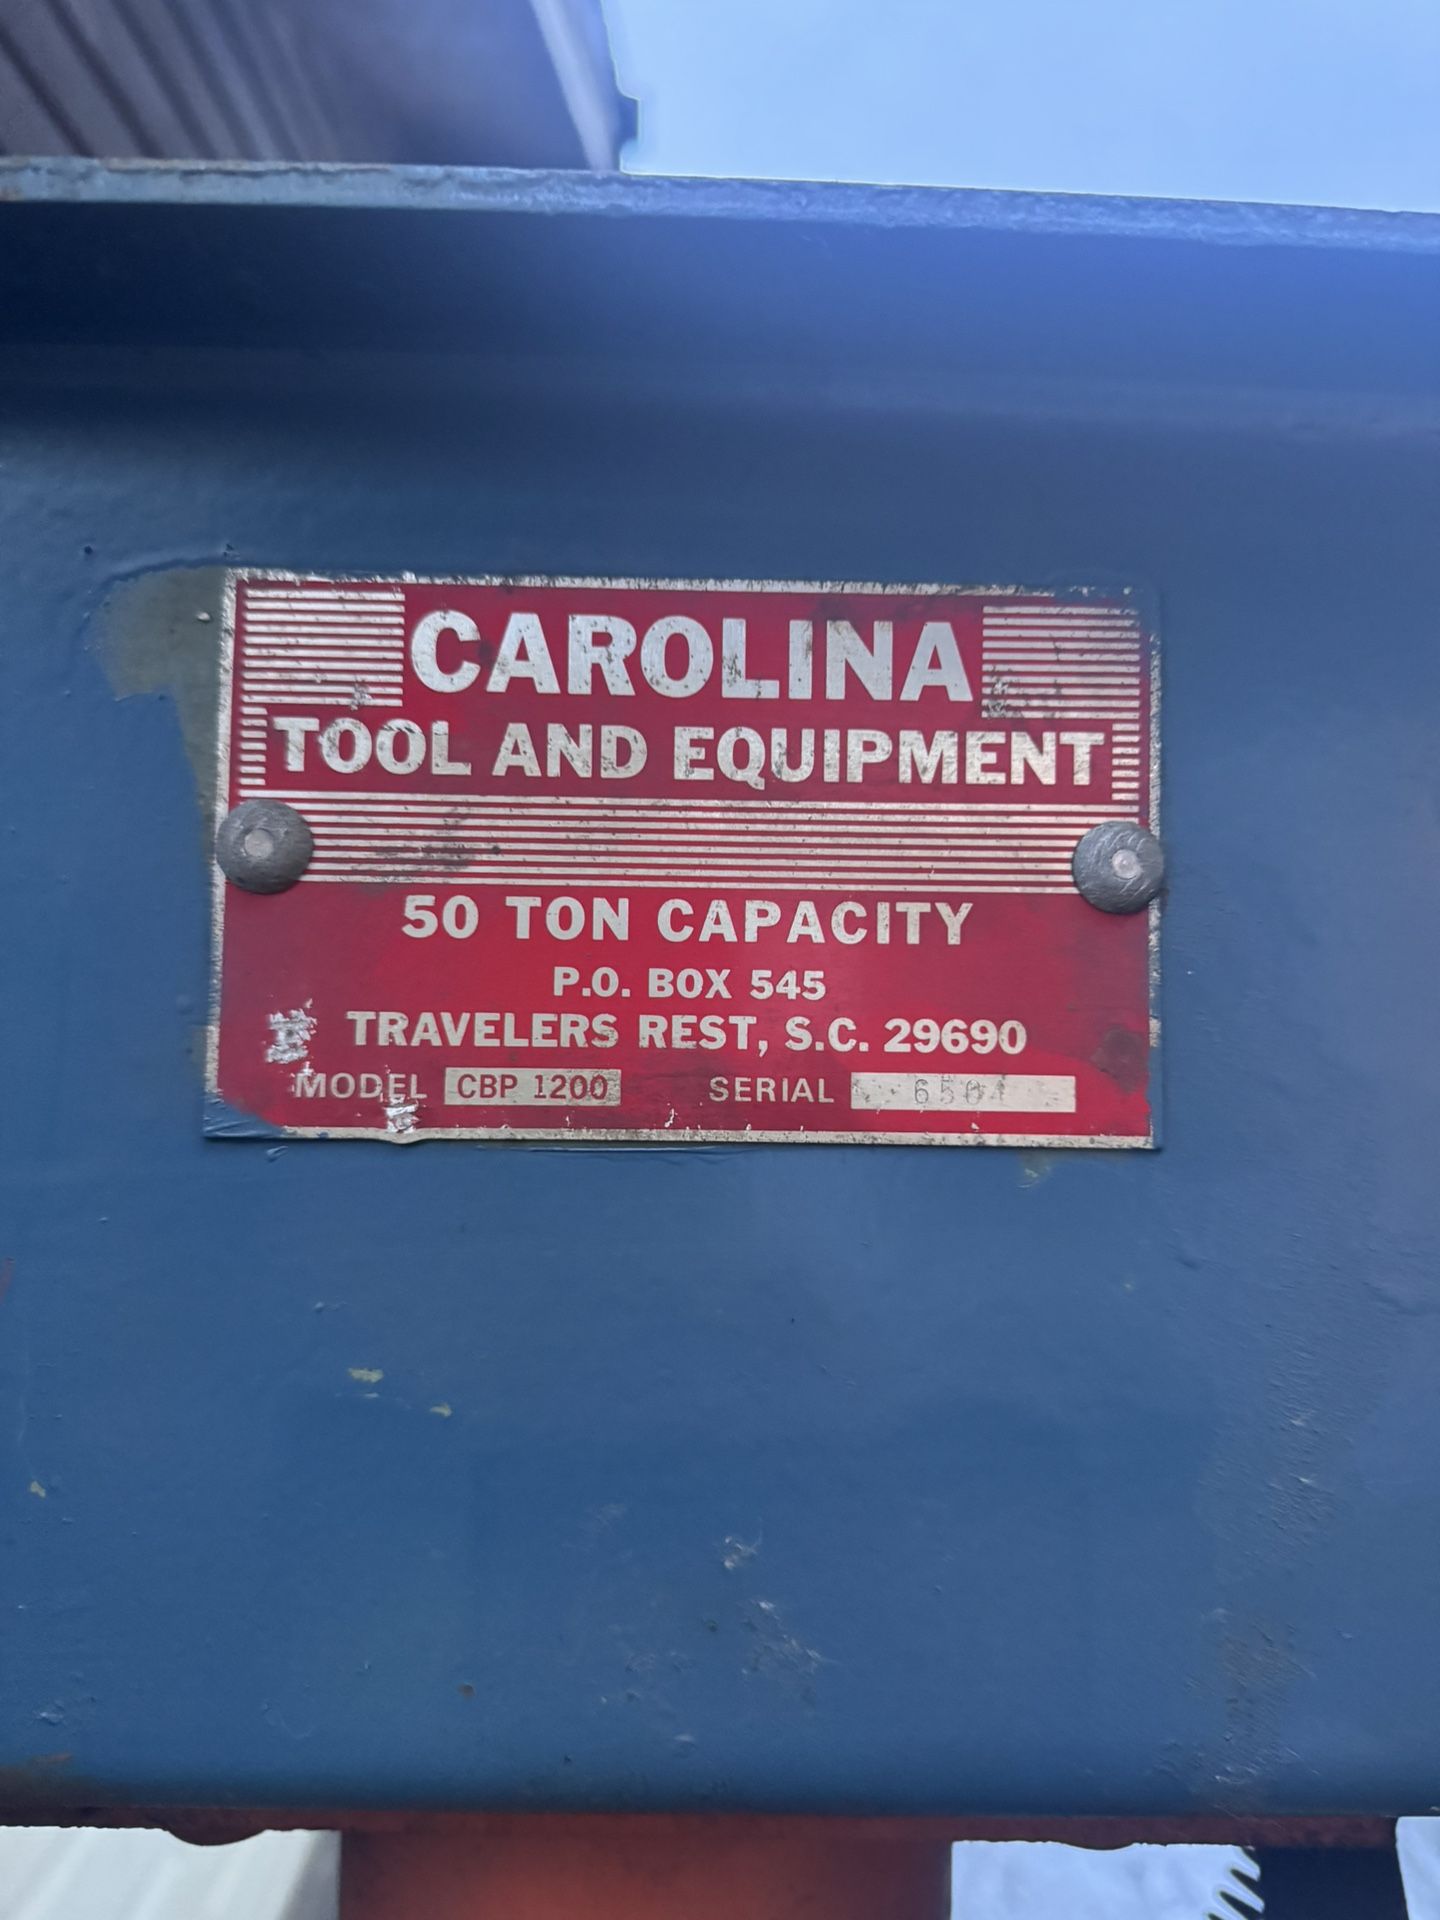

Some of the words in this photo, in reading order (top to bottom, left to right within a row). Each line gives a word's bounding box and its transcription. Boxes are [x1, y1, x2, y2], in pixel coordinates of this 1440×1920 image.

[411, 610, 973, 702] CAROLINA
[273, 716, 472, 775] TOOL
[491, 722, 648, 779] AND
[673, 726, 1105, 790] EQUIPMENT
[401, 894, 479, 940] 50
[505, 896, 630, 941] TON
[657, 898, 974, 946] CAPACITY
[553, 966, 631, 998] P.O.
[648, 967, 732, 999] BOX
[750, 969, 827, 1000] 545
[346, 1010, 619, 1048] TRAVELERS
[639, 1014, 769, 1057] REST,
[785, 1016, 869, 1053] S.C.
[884, 1017, 1028, 1054] 29690
[295, 1072, 427, 1100] MODEL
[456, 1073, 518, 1099] CBP
[534, 1074, 609, 1100] 1200
[709, 1076, 835, 1103] SERIAL
